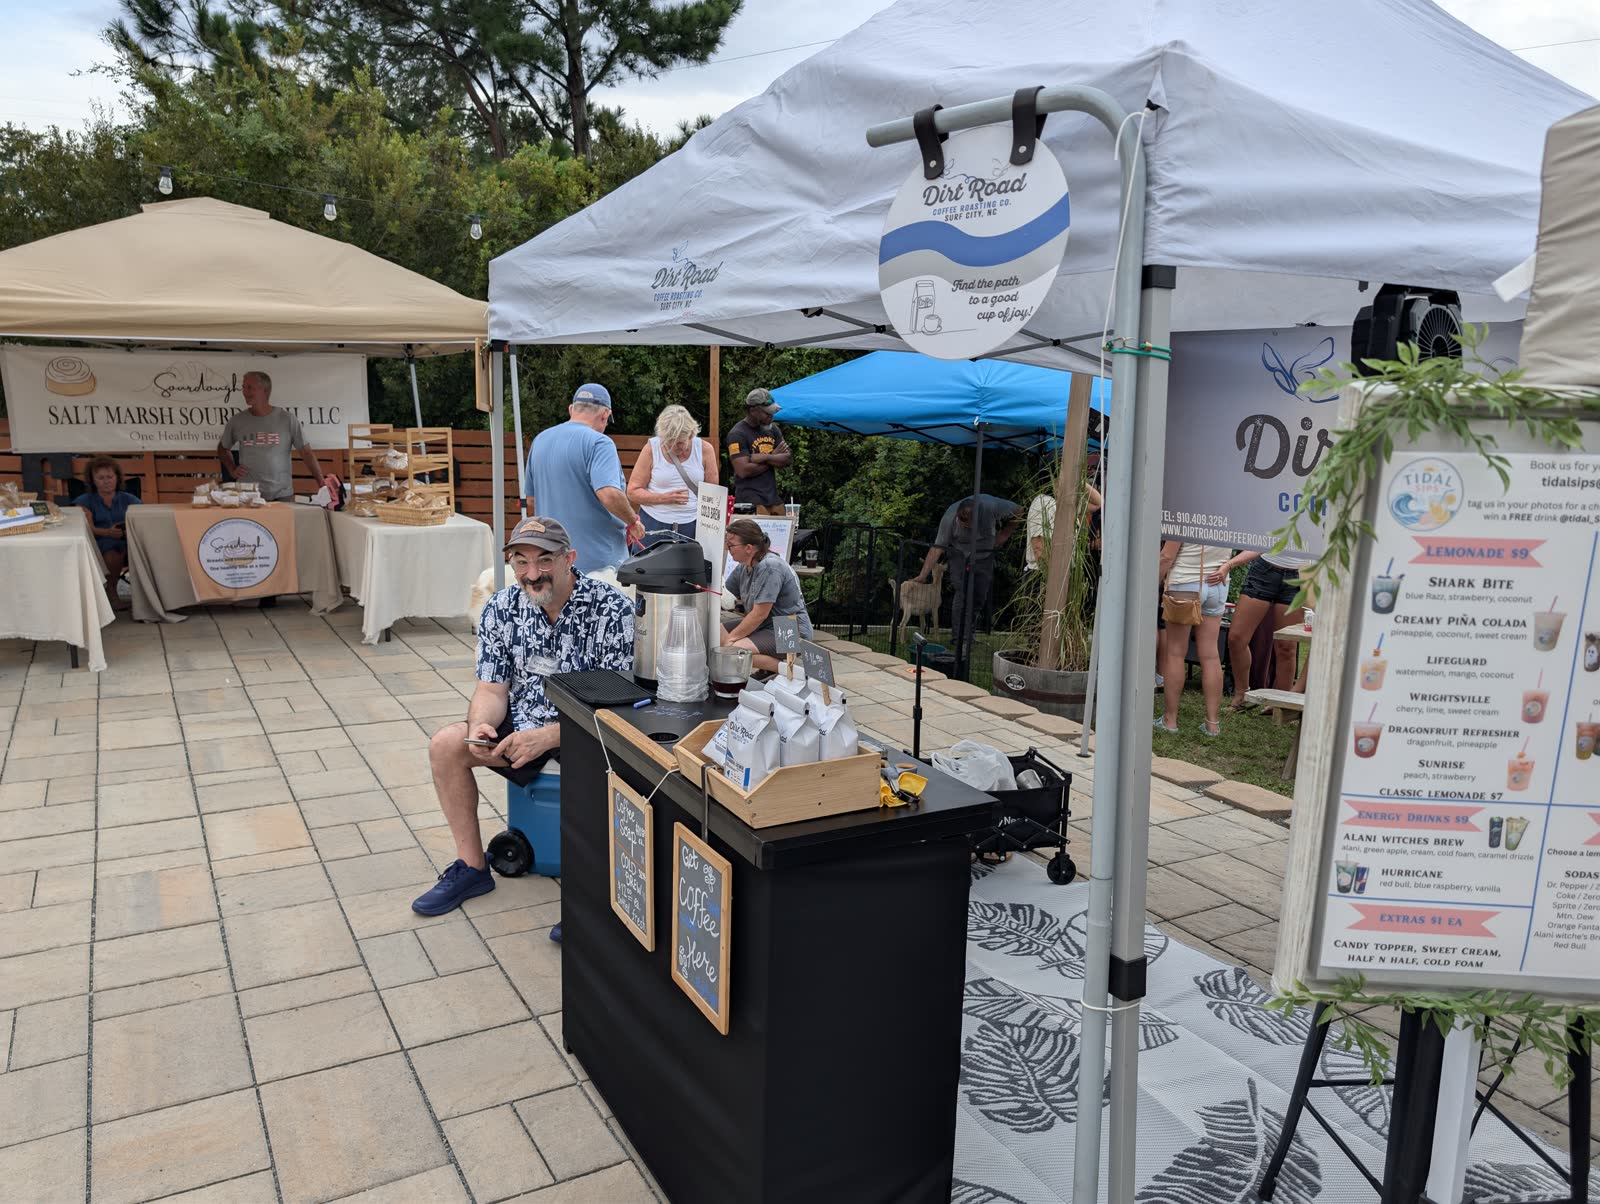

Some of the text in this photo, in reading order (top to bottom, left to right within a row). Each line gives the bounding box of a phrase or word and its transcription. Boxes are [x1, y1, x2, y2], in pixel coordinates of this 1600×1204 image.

[923, 172, 1028, 206] Dirt Road
[932, 198, 1012, 216] COFFEE ROASTING CO.
[944, 208, 998, 222] SURF CITY, NC
[651, 260, 724, 292] Dirt Road
[952, 275, 1020, 293] Find the path
[670, 290, 694, 300] ROASTING
[968, 291, 1019, 308] to a good
[976, 306, 1034, 323] cup of joy!
[154, 371, 243, 404] Sourdough
[48, 405, 100, 426] SALT
[104, 406, 174, 425] MARSH
[308, 406, 340, 425] LLC
[130, 430, 154, 442] One
[158, 430, 202, 444] Healthy
[243, 432, 280, 447] USA
[1236, 414, 1334, 480] Dir
[1530, 460, 1590, 470] Book us for
[1403, 472, 1452, 488] TIDAL
[1468, 500, 1482, 510] tag
[1496, 500, 1506, 508] in
[1507, 501, 1528, 510] your
[1530, 500, 1562, 511] photos
[1565, 501, 1578, 510] for
[1161, 510, 1228, 528] TEL: 910.409.3264
[1483, 512, 1499, 520] win
[1508, 513, 1532, 522] FREE
[1534, 514, 1558, 522] drink
[1426, 544, 1530, 560] LEMONADE $9
[1405, 592, 1533, 604] blue Razz, strawberry, coconut
[1390, 628, 1528, 641] pineapple, coconut, sweet cream
[1395, 668, 1514, 680] watermelon, mango, coconut
[1396, 704, 1424, 714] cherry,
[1426, 705, 1446, 714] lime,
[1447, 707, 1471, 716] sweet
[1406, 738, 1498, 750] dragonfruit, pineapple
[1418, 759, 1466, 770] SUNRISE
[1403, 772, 1476, 783] peach, strawberry
[1379, 788, 1504, 801] CLASSIC LEMONADE $7
[616, 792, 636, 823] Coffee
[1357, 810, 1470, 825] ENERGY DRINKS $9
[620, 818, 638, 858] Soap
[1343, 832, 1465, 848] ALANI WITCHES BREW
[682, 845, 699, 870] Get
[1341, 844, 1534, 861] alani, green apple, cream, cold foam, caramel drizzle
[1546, 848, 1578, 857] Choose
[620, 852, 636, 876] COLD
[1381, 868, 1444, 879] HURRICANE
[1564, 870, 1600, 880] SODAS
[624, 870, 642, 896] BREW
[1379, 880, 1502, 893] red bull, blue raspberry, vanilla
[1560, 882, 1588, 891] Pepper
[1556, 892, 1600, 901] Coke Zero
[678, 876, 720, 938] Coffee
[1552, 902, 1600, 912] Sprite Zero
[1379, 912, 1463, 926] EXTRAS $1 EA
[1556, 912, 1594, 921] Mtn. Dew
[1547, 922, 1600, 931] Orange Fanta
[1534, 931, 1554, 939] Alani
[1555, 932, 1588, 940] witche's
[1570, 942, 1586, 950] Bull
[686, 936, 718, 984] Here
[1348, 954, 1484, 968] HALF N HALF, COLD FOAM
